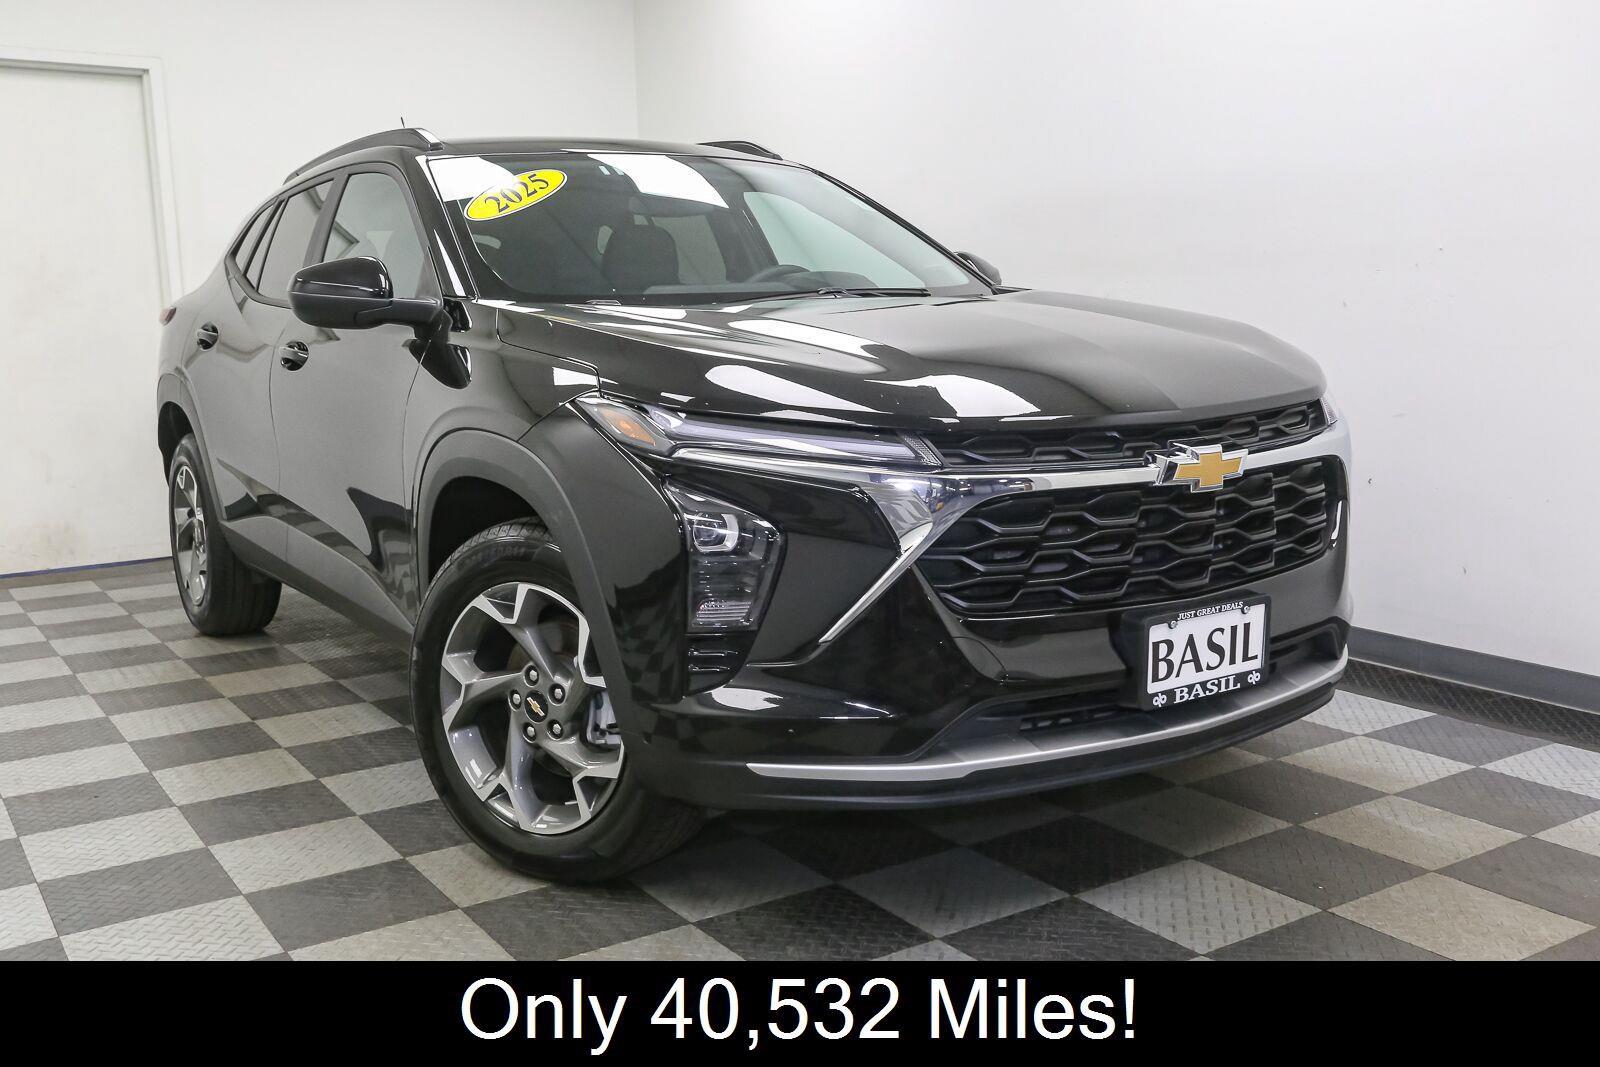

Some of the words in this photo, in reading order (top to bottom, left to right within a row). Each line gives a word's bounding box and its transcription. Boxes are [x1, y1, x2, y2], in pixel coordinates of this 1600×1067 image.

[484, 173, 549, 213] 2025
[1177, 610, 1196, 621] JUST
[1197, 605, 1221, 617] GREAT
[1221, 601, 1244, 612] DEALS
[1151, 621, 1259, 684] BASIL
[1173, 675, 1241, 704] BASIL
